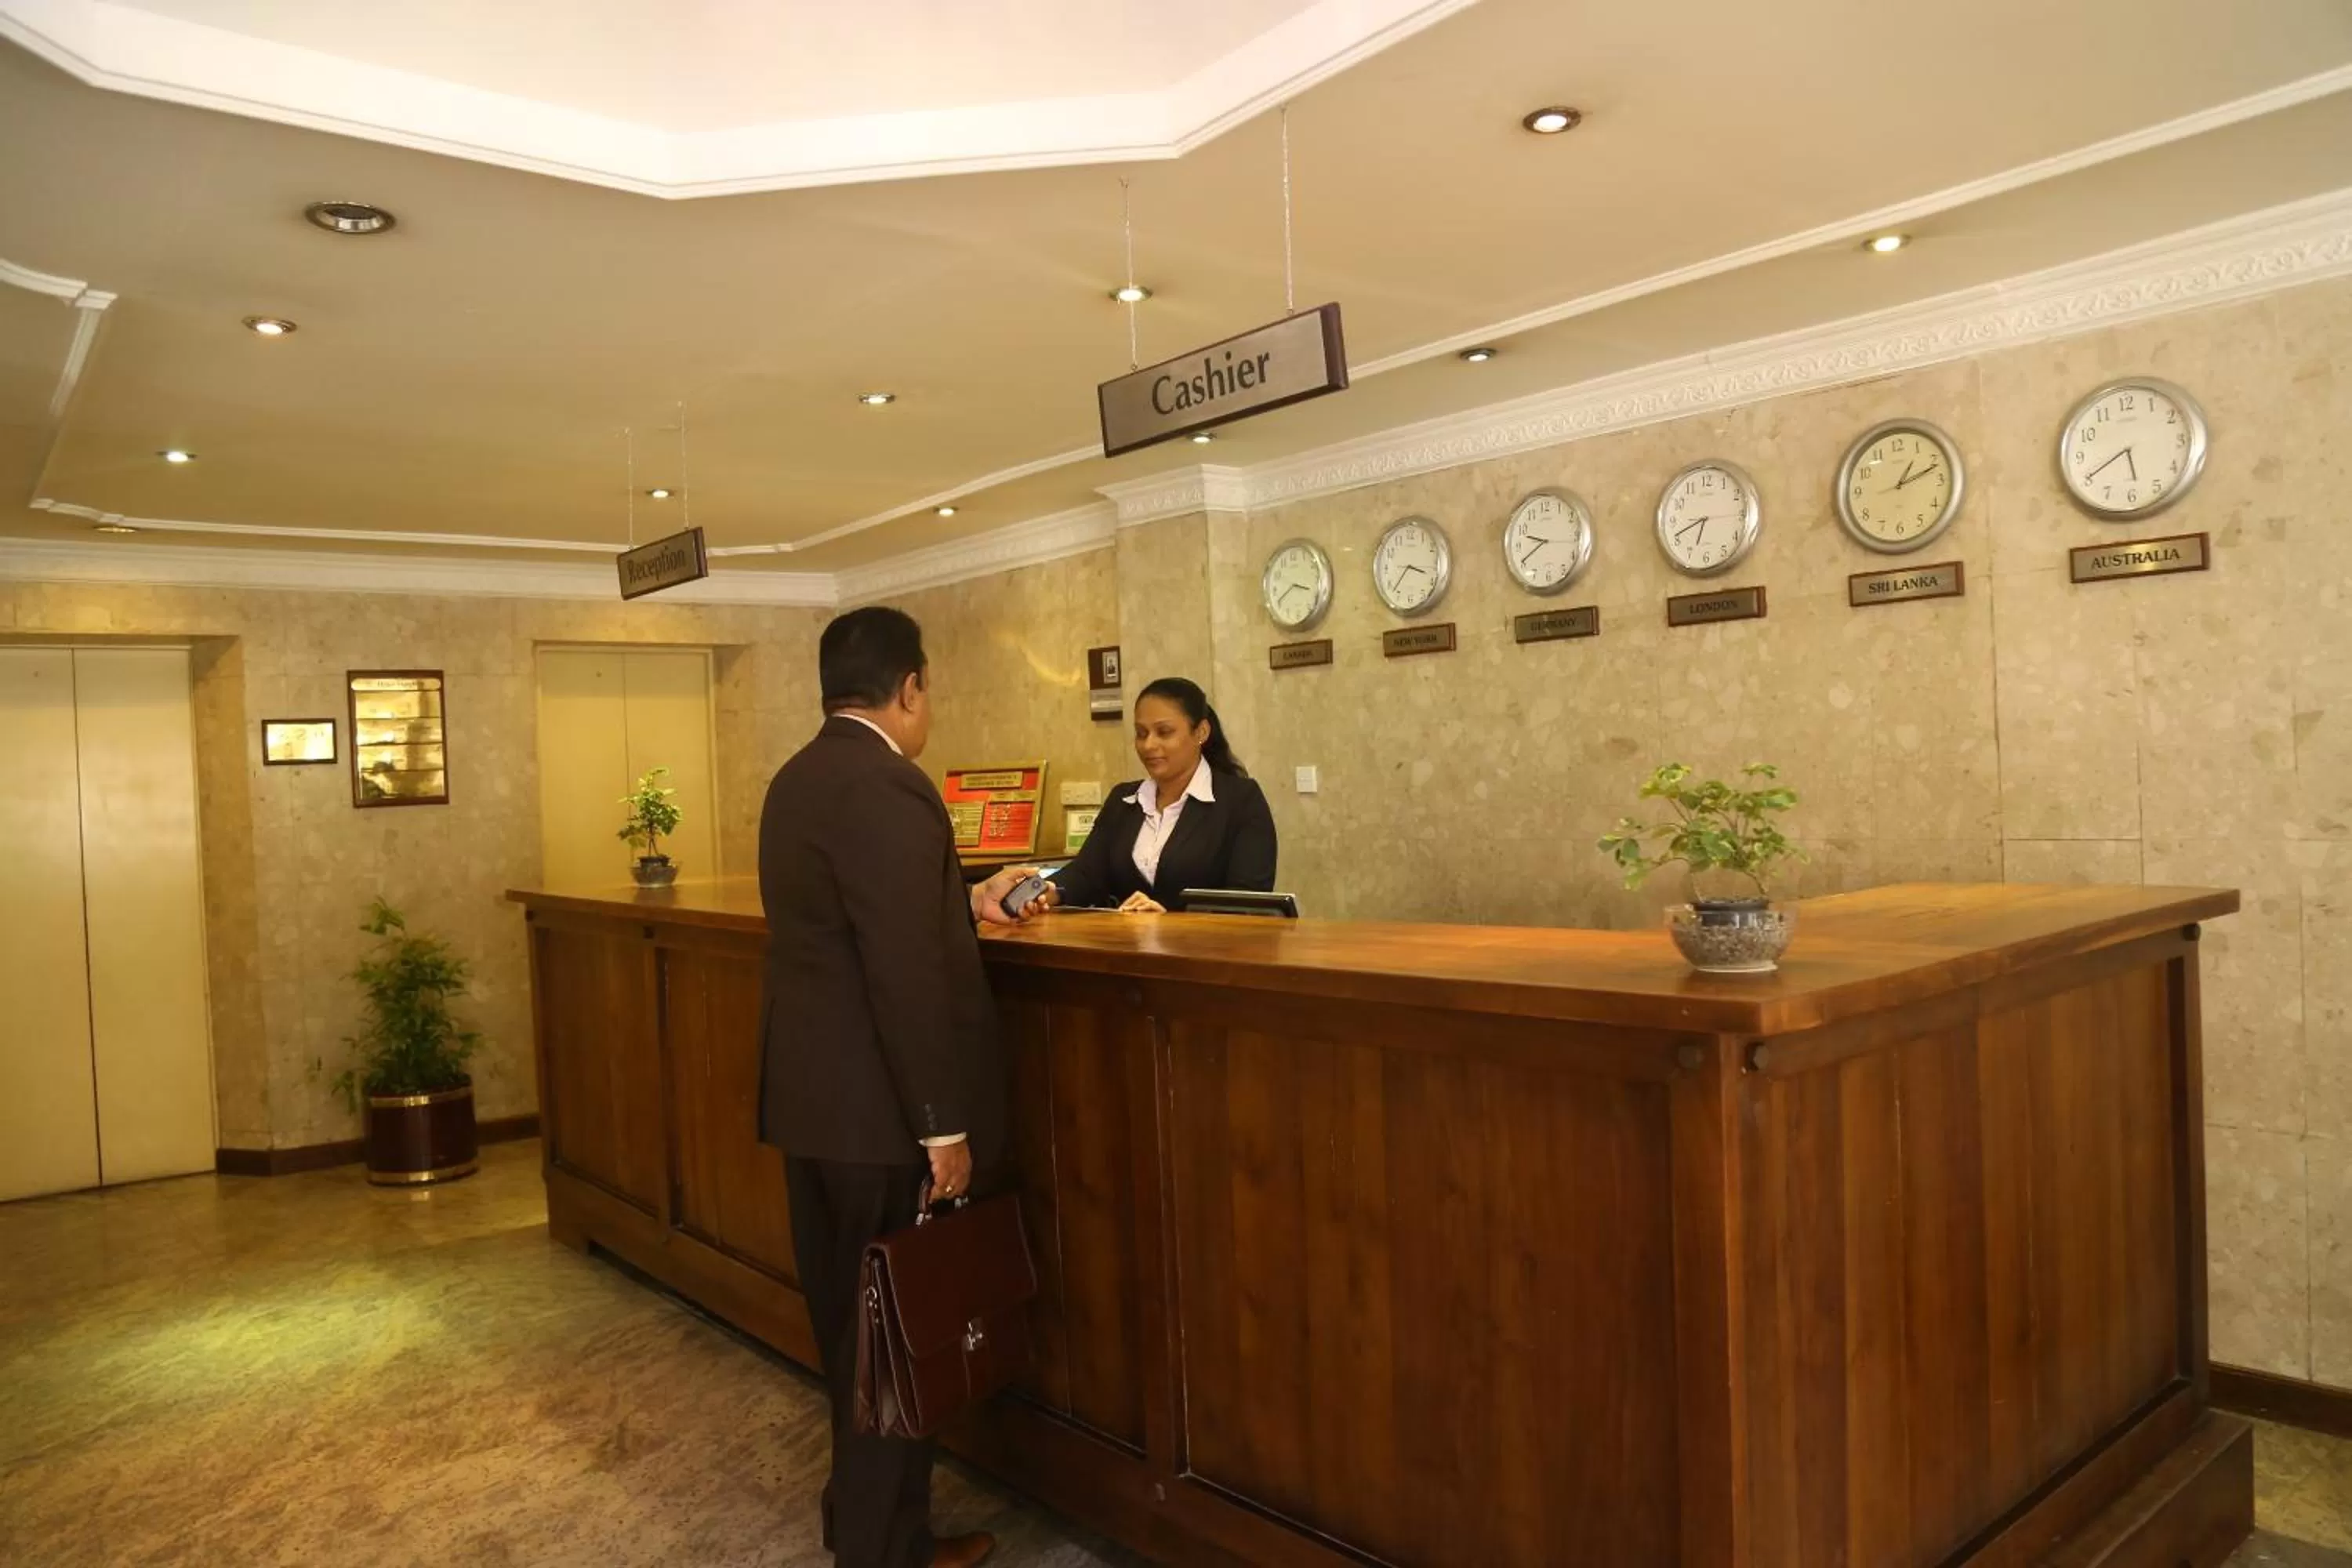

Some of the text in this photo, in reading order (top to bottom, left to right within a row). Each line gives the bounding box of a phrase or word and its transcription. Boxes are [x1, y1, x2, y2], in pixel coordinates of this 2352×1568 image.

[1151, 350, 1271, 416] Cashier
[2119, 395, 2133, 411] 12
[2148, 397, 2154, 412] 1
[2097, 407, 2110, 423] 11
[2166, 408, 2176, 424] 2
[2082, 427, 2096, 444] 10
[2176, 433, 2186, 448] 3
[1892, 439, 1904, 452] 12
[1915, 440, 1920, 454] 1
[2075, 451, 2085, 465] 9
[1860, 466, 1872, 481] 10
[2169, 459, 2178, 474] 4
[1702, 475, 1712, 487] 12
[1722, 477, 1726, 490] 1
[1936, 473, 1945, 487] 3
[2152, 478, 2162, 494] 5
[1686, 482, 1694, 495] 11
[1733, 488, 1740, 501] 2
[1853, 485, 1862, 499] 9
[2103, 485, 2111, 500] 7
[2127, 488, 2136, 503] 6
[1675, 498, 1685, 511] 10
[1929, 495, 1939, 510] 4
[1862, 507, 1870, 521] 8
[1916, 514, 1925, 528] 5
[1669, 516, 1676, 528] 9
[1877, 519, 1886, 533] 7
[1896, 521, 1904, 536] 6
[1731, 530, 1738, 542] 4
[1686, 546, 1693, 559] 7
[1702, 551, 1710, 564] 6
[1720, 545, 1727, 557] 5
[627, 545, 686, 584] Reception
[2090, 548, 2182, 570] AUSTRALIA
[1868, 576, 1939, 594] SRI LANKA
[1690, 600, 1738, 615] LONDON
